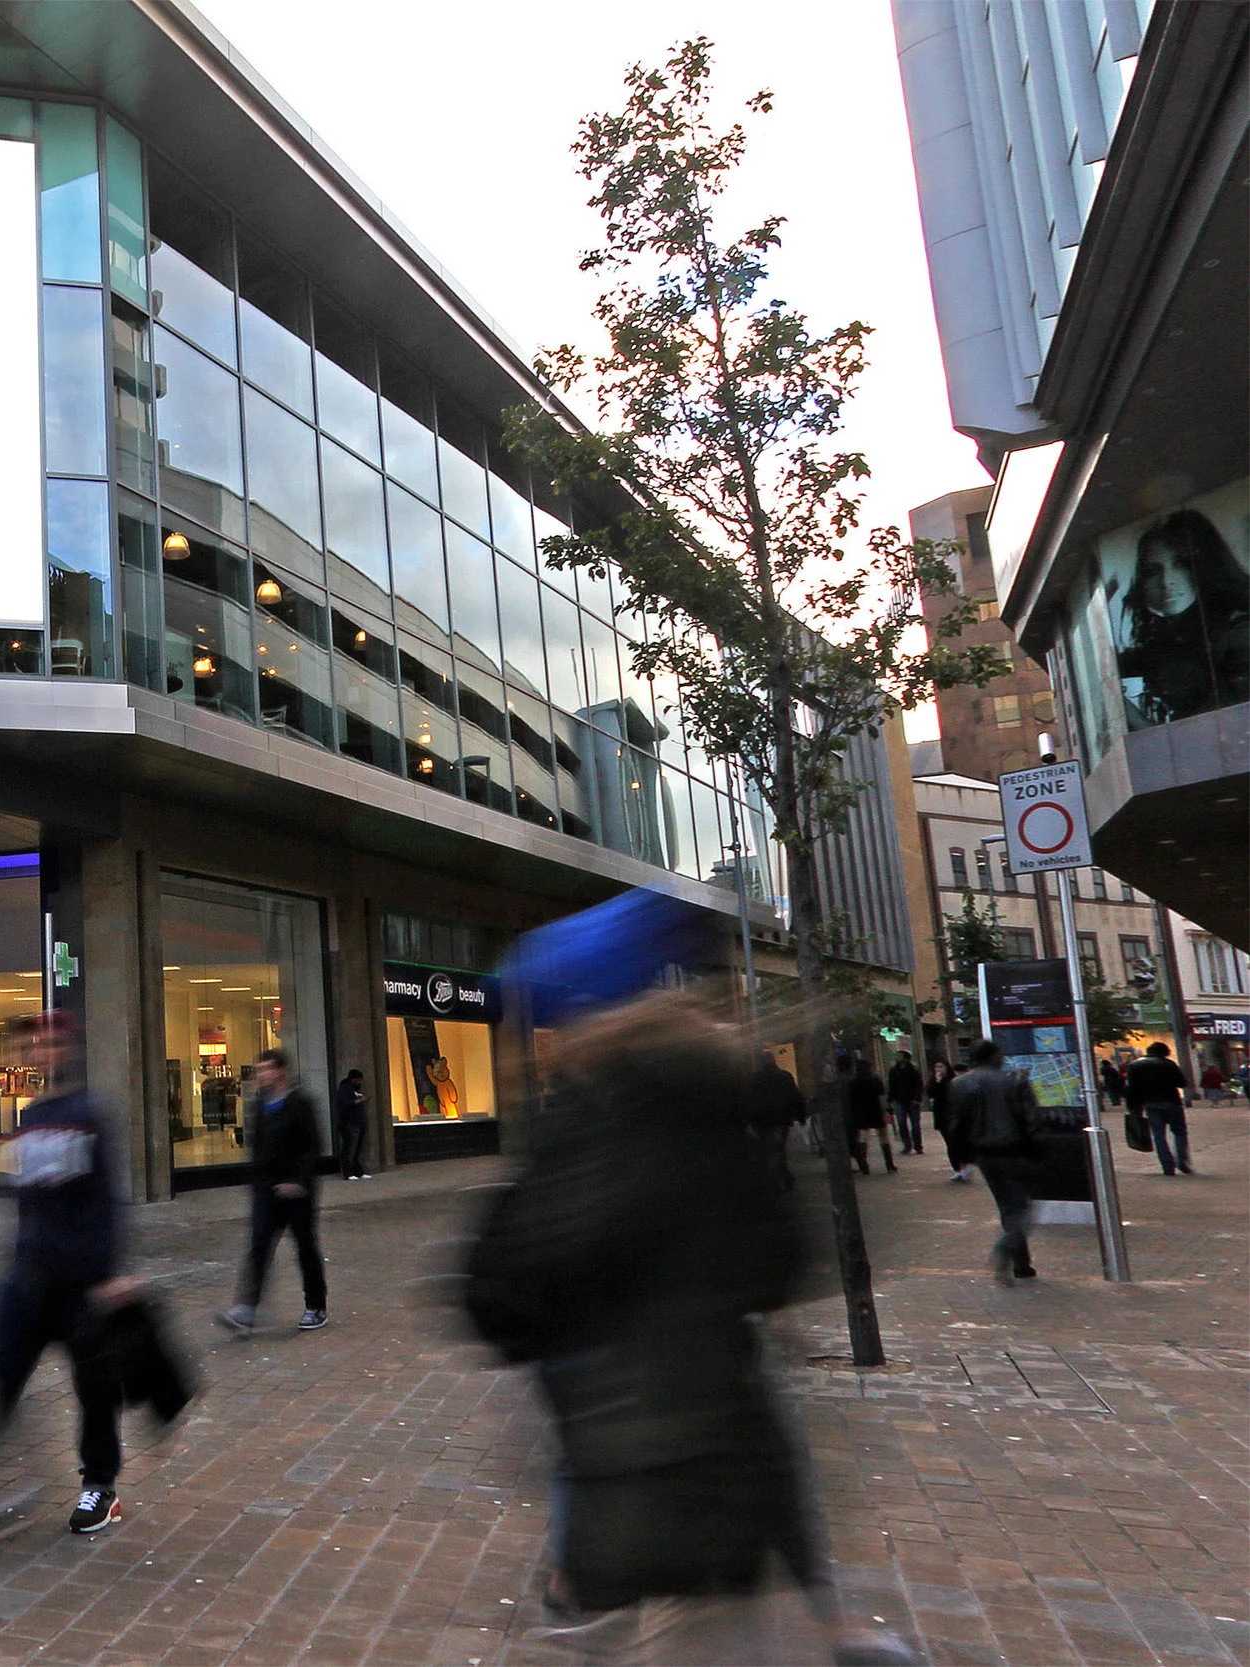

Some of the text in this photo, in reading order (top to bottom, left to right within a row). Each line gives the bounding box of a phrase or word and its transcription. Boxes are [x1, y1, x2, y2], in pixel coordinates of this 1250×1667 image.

[1002, 765, 1076, 785] PEDESTRIAN
[1014, 779, 1067, 800] ZONE
[1020, 854, 1081, 868] No vehicles
[459, 986, 485, 1006] beauty
